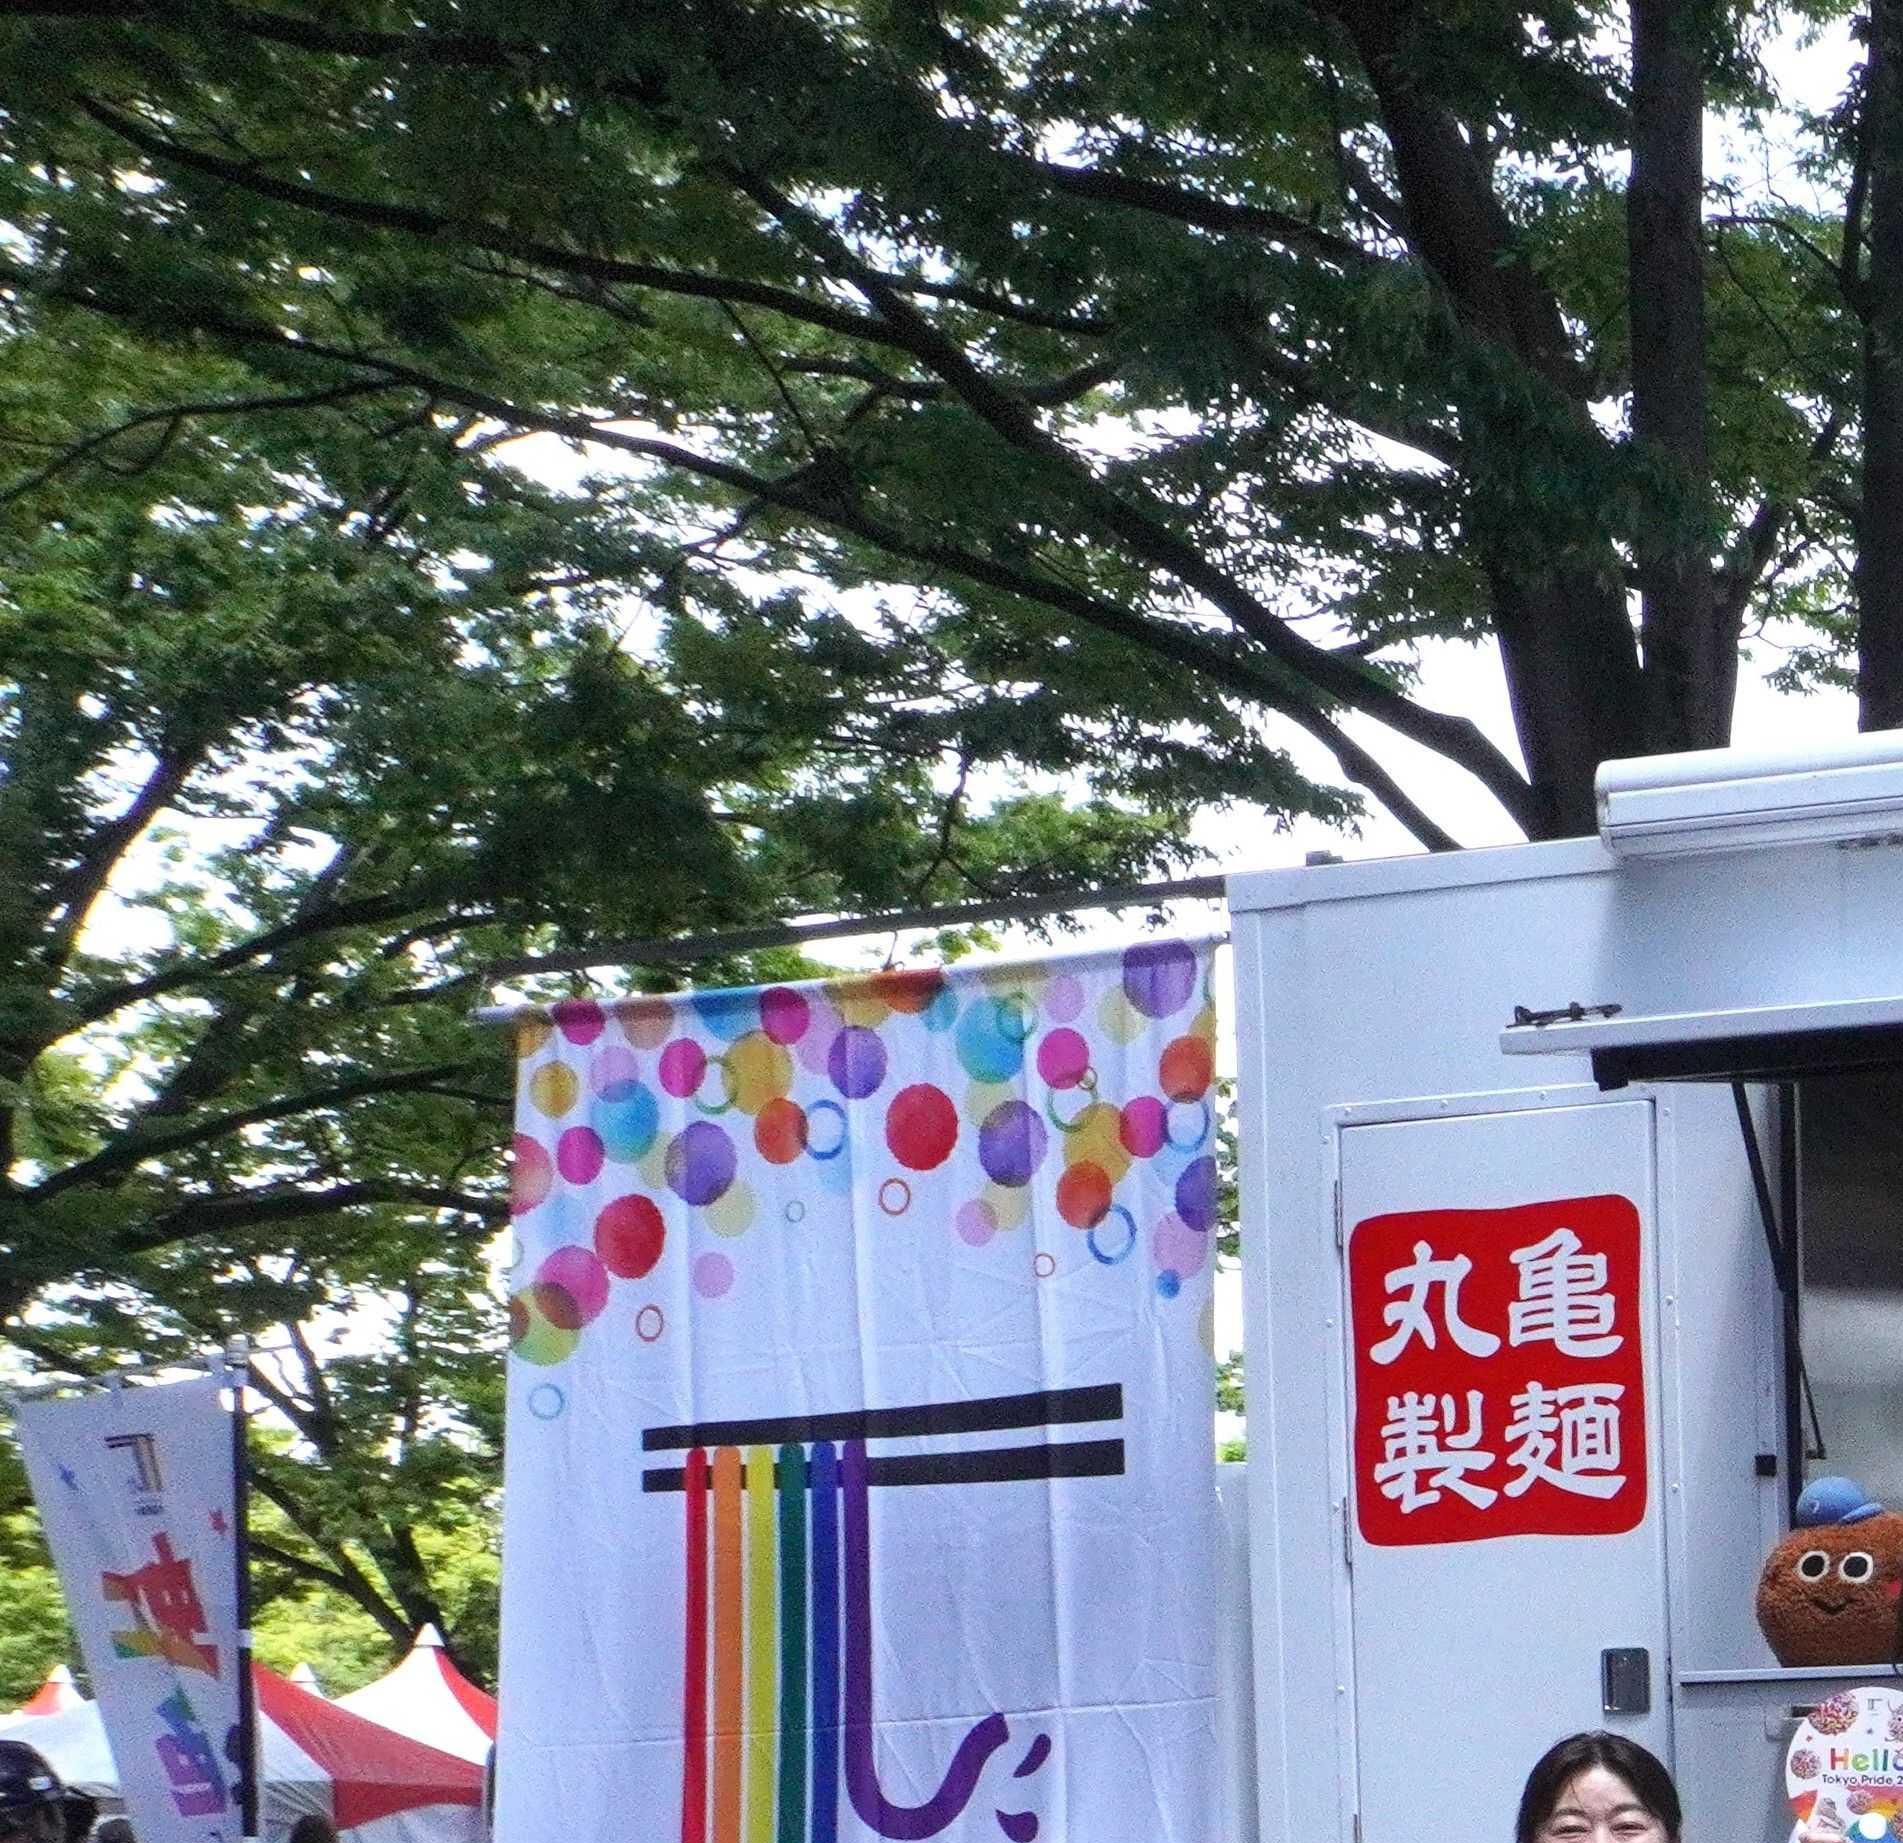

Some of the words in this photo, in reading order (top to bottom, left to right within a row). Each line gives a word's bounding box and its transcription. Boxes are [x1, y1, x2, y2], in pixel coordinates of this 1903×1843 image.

[1369, 1227, 1624, 1365] 丸亀
[1374, 1381, 1627, 1513] 製麺
[1822, 1774, 1858, 1786] Tokyo
[1861, 1774, 1893, 1786] Pride
